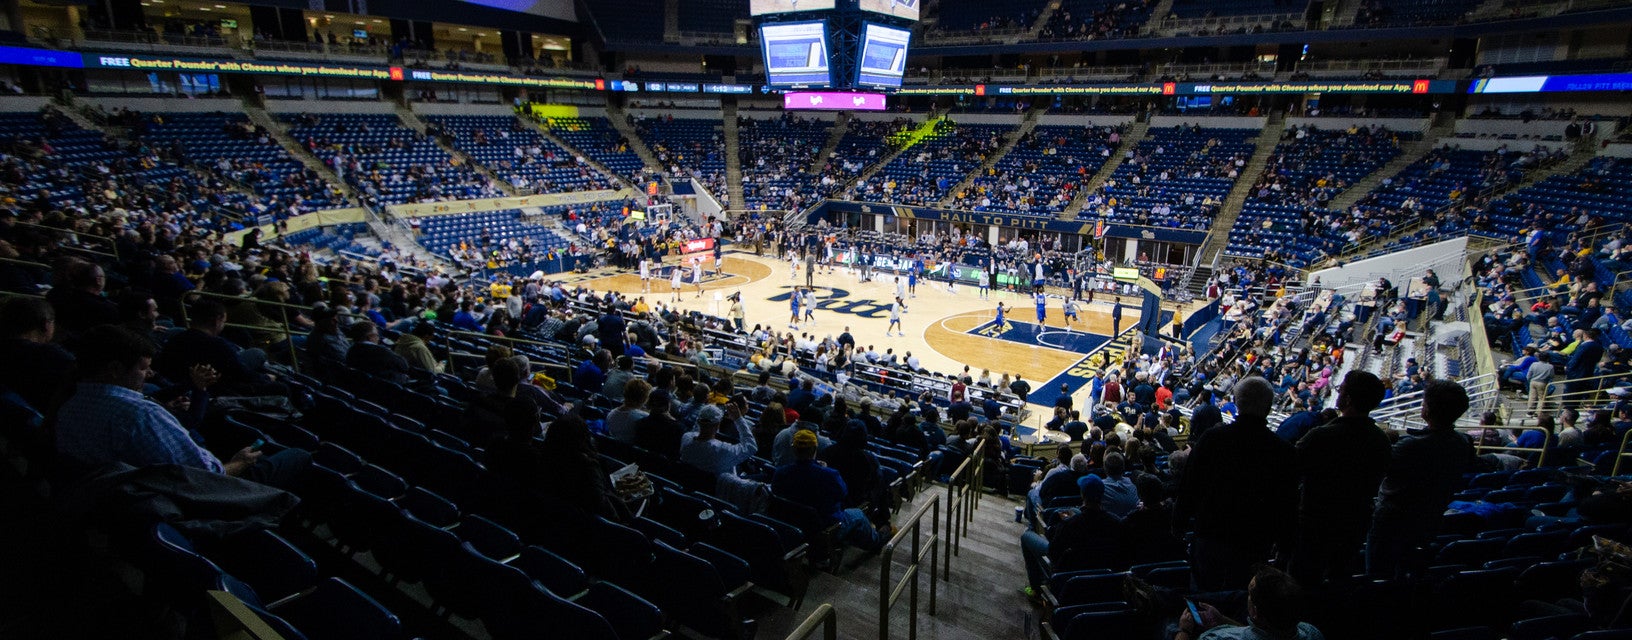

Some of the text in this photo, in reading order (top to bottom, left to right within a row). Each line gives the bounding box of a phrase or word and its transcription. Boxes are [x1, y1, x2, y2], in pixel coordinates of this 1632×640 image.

[100, 57, 130, 67] FREE
[130, 58, 172, 68] Quarter
[218, 63, 241, 71] with
[241, 62, 276, 72] Cheese
[276, 64, 301, 73] when
[301, 67, 318, 75] you
[318, 66, 358, 76] download
[1194, 85, 1211, 93] FREE
[1265, 84, 1281, 92] with
[940, 212, 1048, 229] HAIL TO PITT
[767, 285, 893, 318] Pitt
